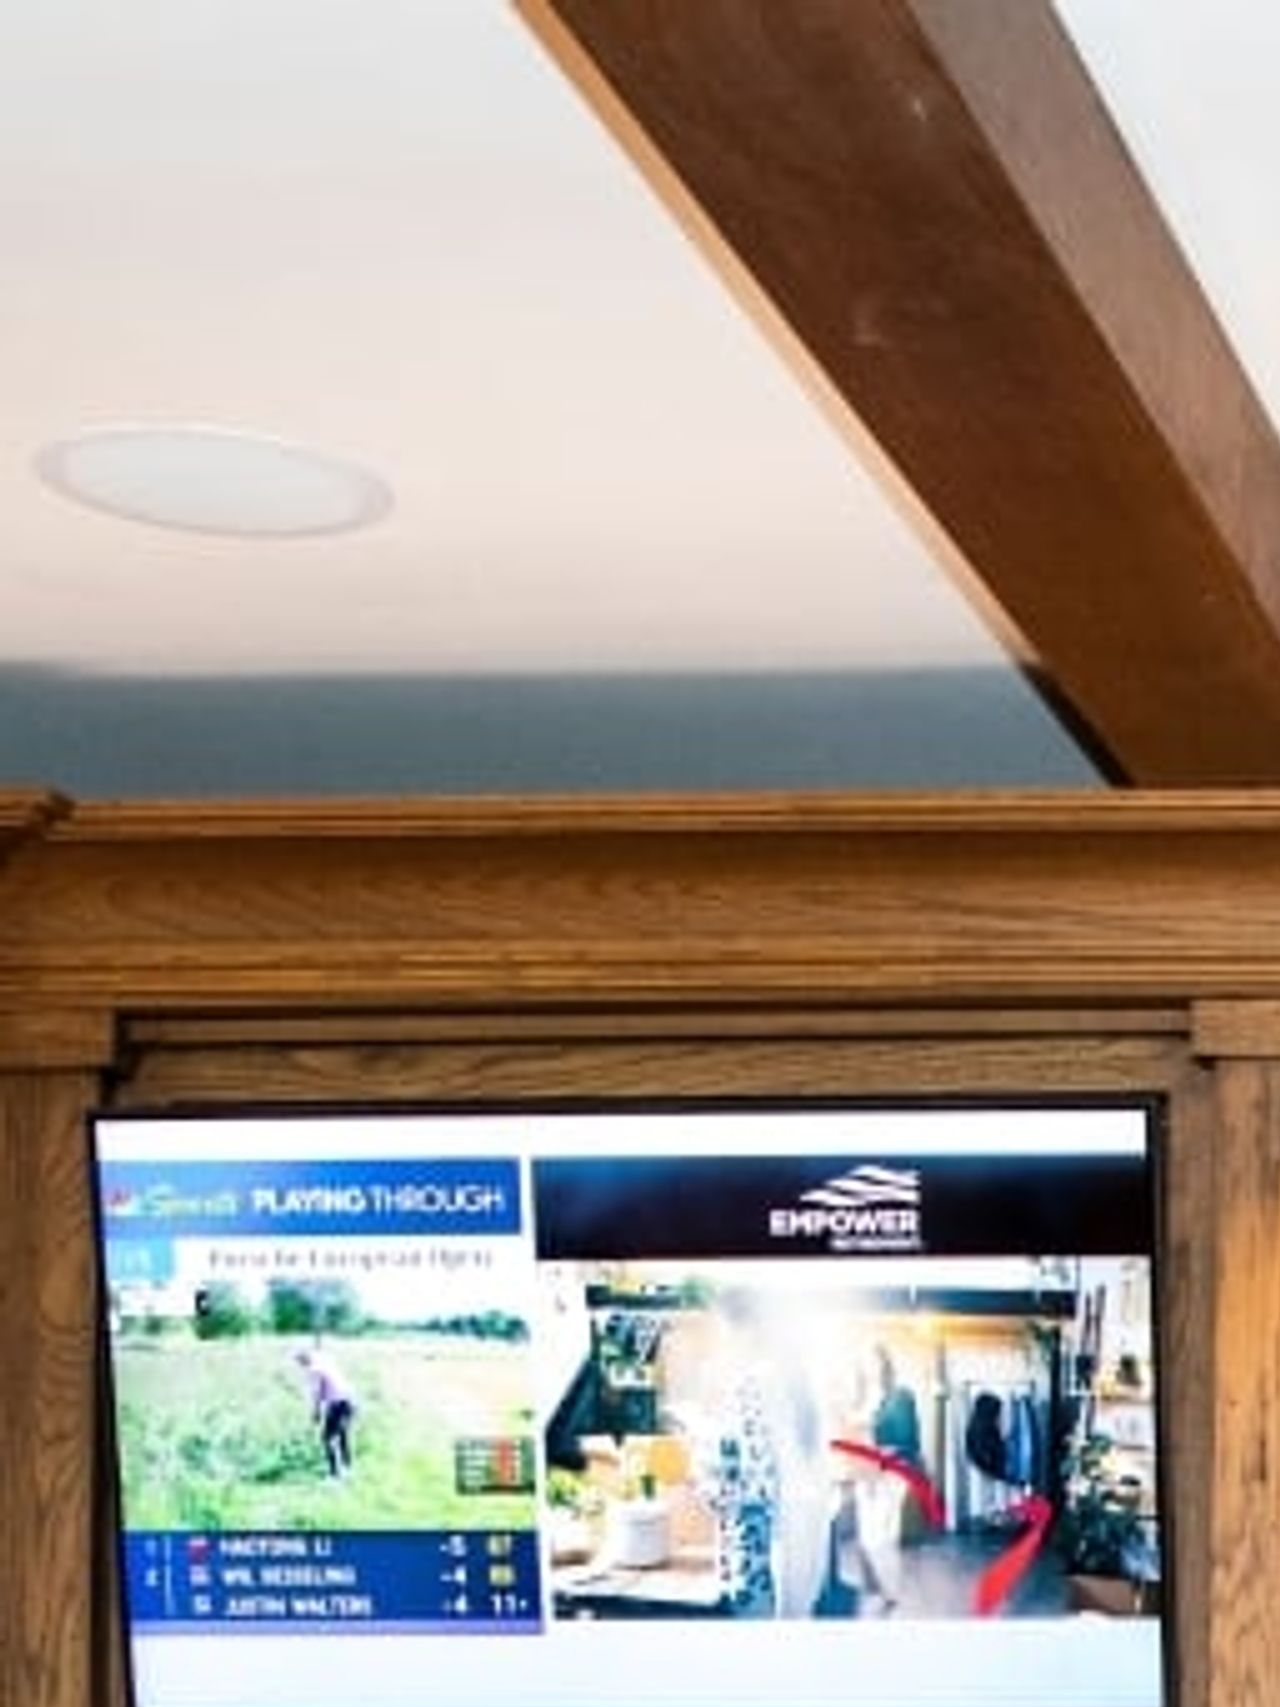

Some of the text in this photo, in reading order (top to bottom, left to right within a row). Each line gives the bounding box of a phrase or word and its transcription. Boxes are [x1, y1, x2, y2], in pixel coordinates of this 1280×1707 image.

[250, 1187, 368, 1214] PLAYING
[372, 1184, 505, 1212] THROUGH
[769, 1209, 918, 1237] EMPOWER
